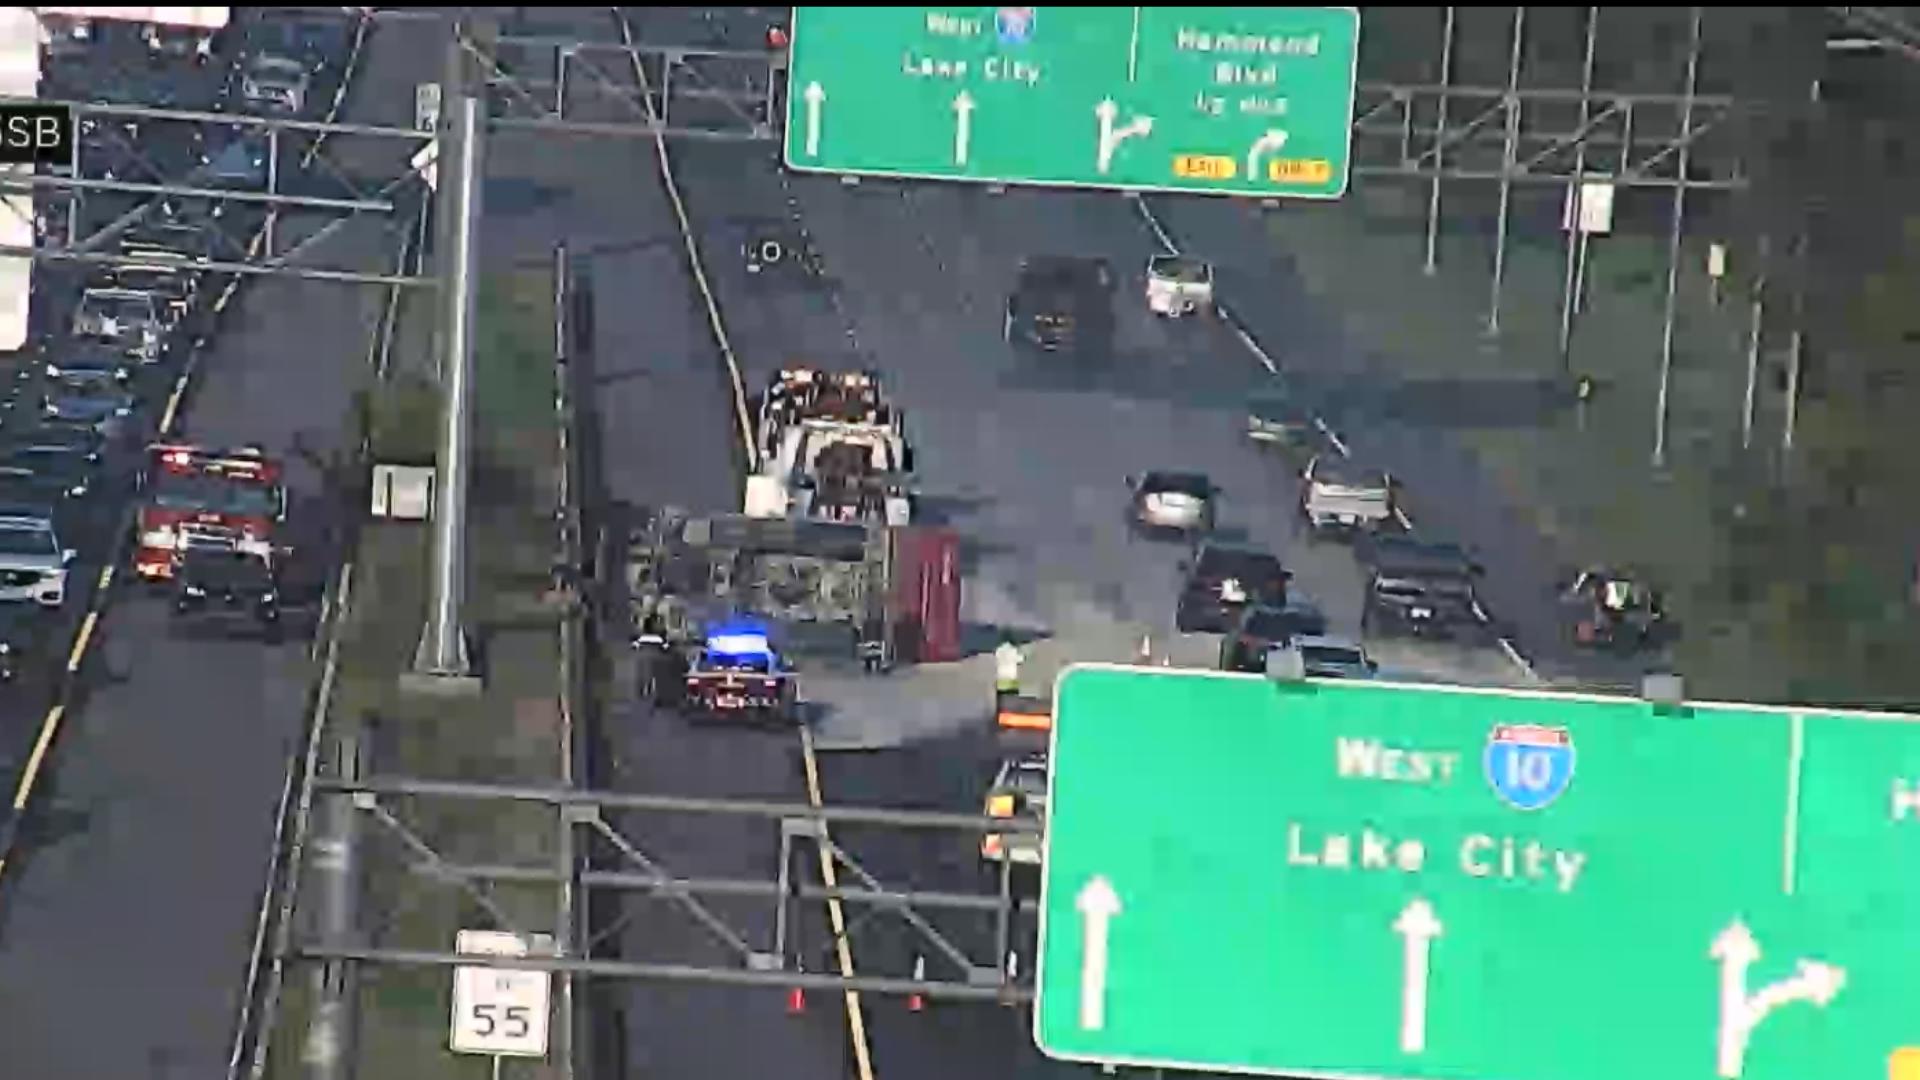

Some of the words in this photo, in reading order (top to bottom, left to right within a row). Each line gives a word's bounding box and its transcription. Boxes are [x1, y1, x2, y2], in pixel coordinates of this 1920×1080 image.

[1507, 749, 1552, 789] 10
[1288, 823, 1424, 873] Lake
[1460, 834, 1587, 891] City
[473, 1004, 530, 1037] 55
